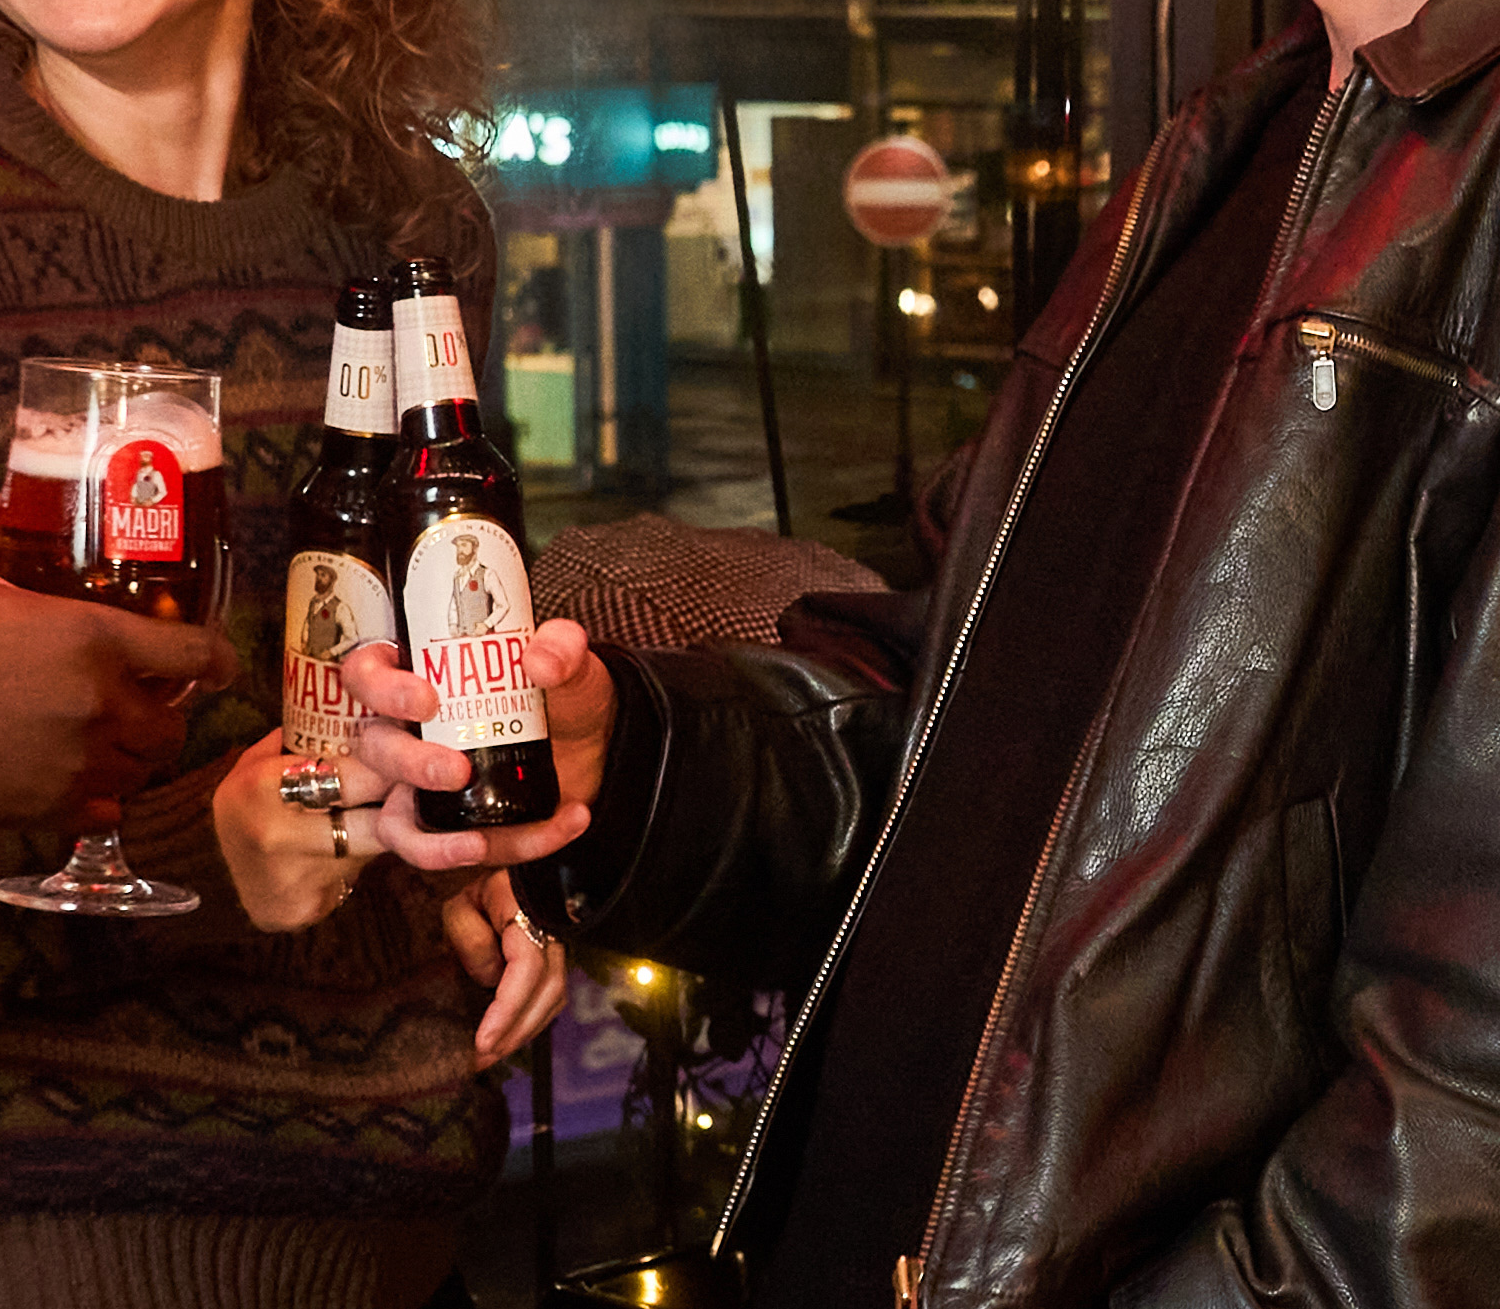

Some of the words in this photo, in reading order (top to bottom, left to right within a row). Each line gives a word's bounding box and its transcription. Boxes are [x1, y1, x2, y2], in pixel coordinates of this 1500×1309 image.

[339, 363, 388, 400] 0.0%
[283, 650, 380, 718] MAD
[421, 635, 536, 699] MADR
[439, 693, 534, 723] EXCEPCIONAL
[456, 719, 523, 743] ZERO
